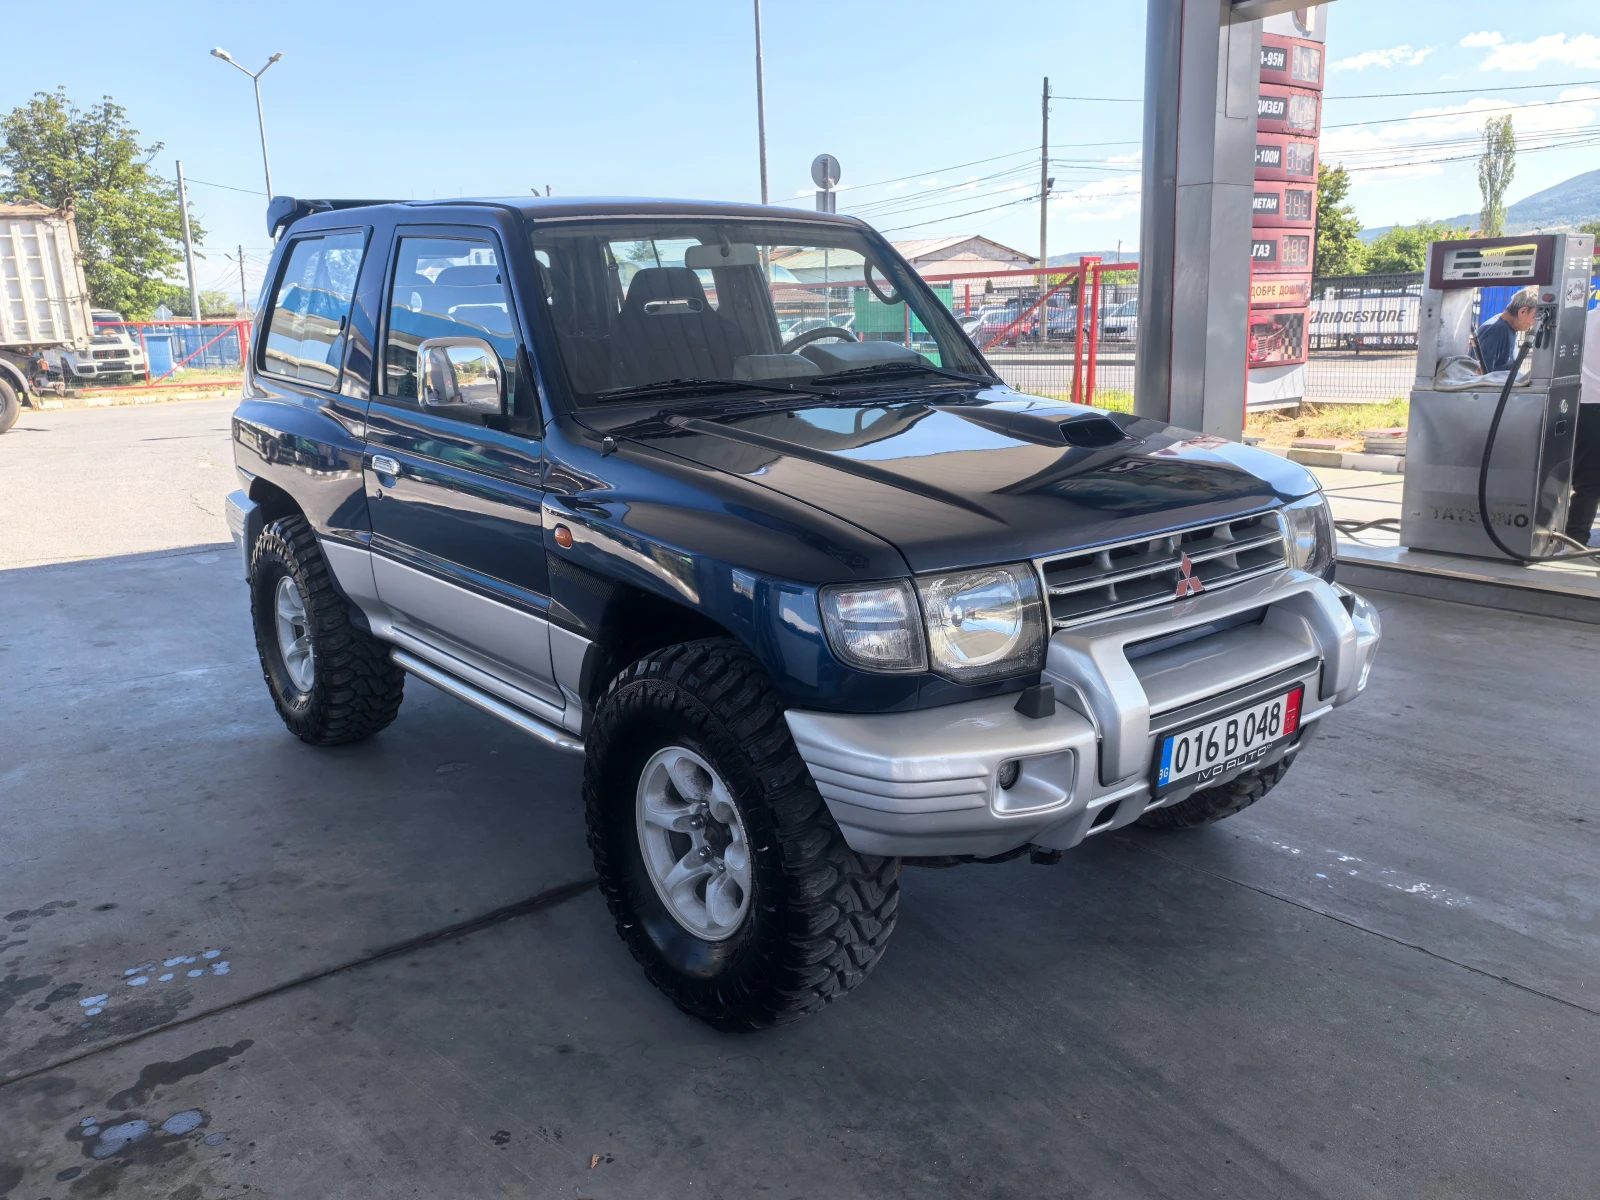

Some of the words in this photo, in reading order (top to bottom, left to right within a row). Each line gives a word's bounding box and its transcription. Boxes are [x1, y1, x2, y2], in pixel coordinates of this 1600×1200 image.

[1253, 244, 1270, 257] ГАЗ
[1309, 309, 1406, 324] BRIDGESTONE
[1197, 763, 1224, 781] IVO
[1226, 747, 1266, 770] AUTO
